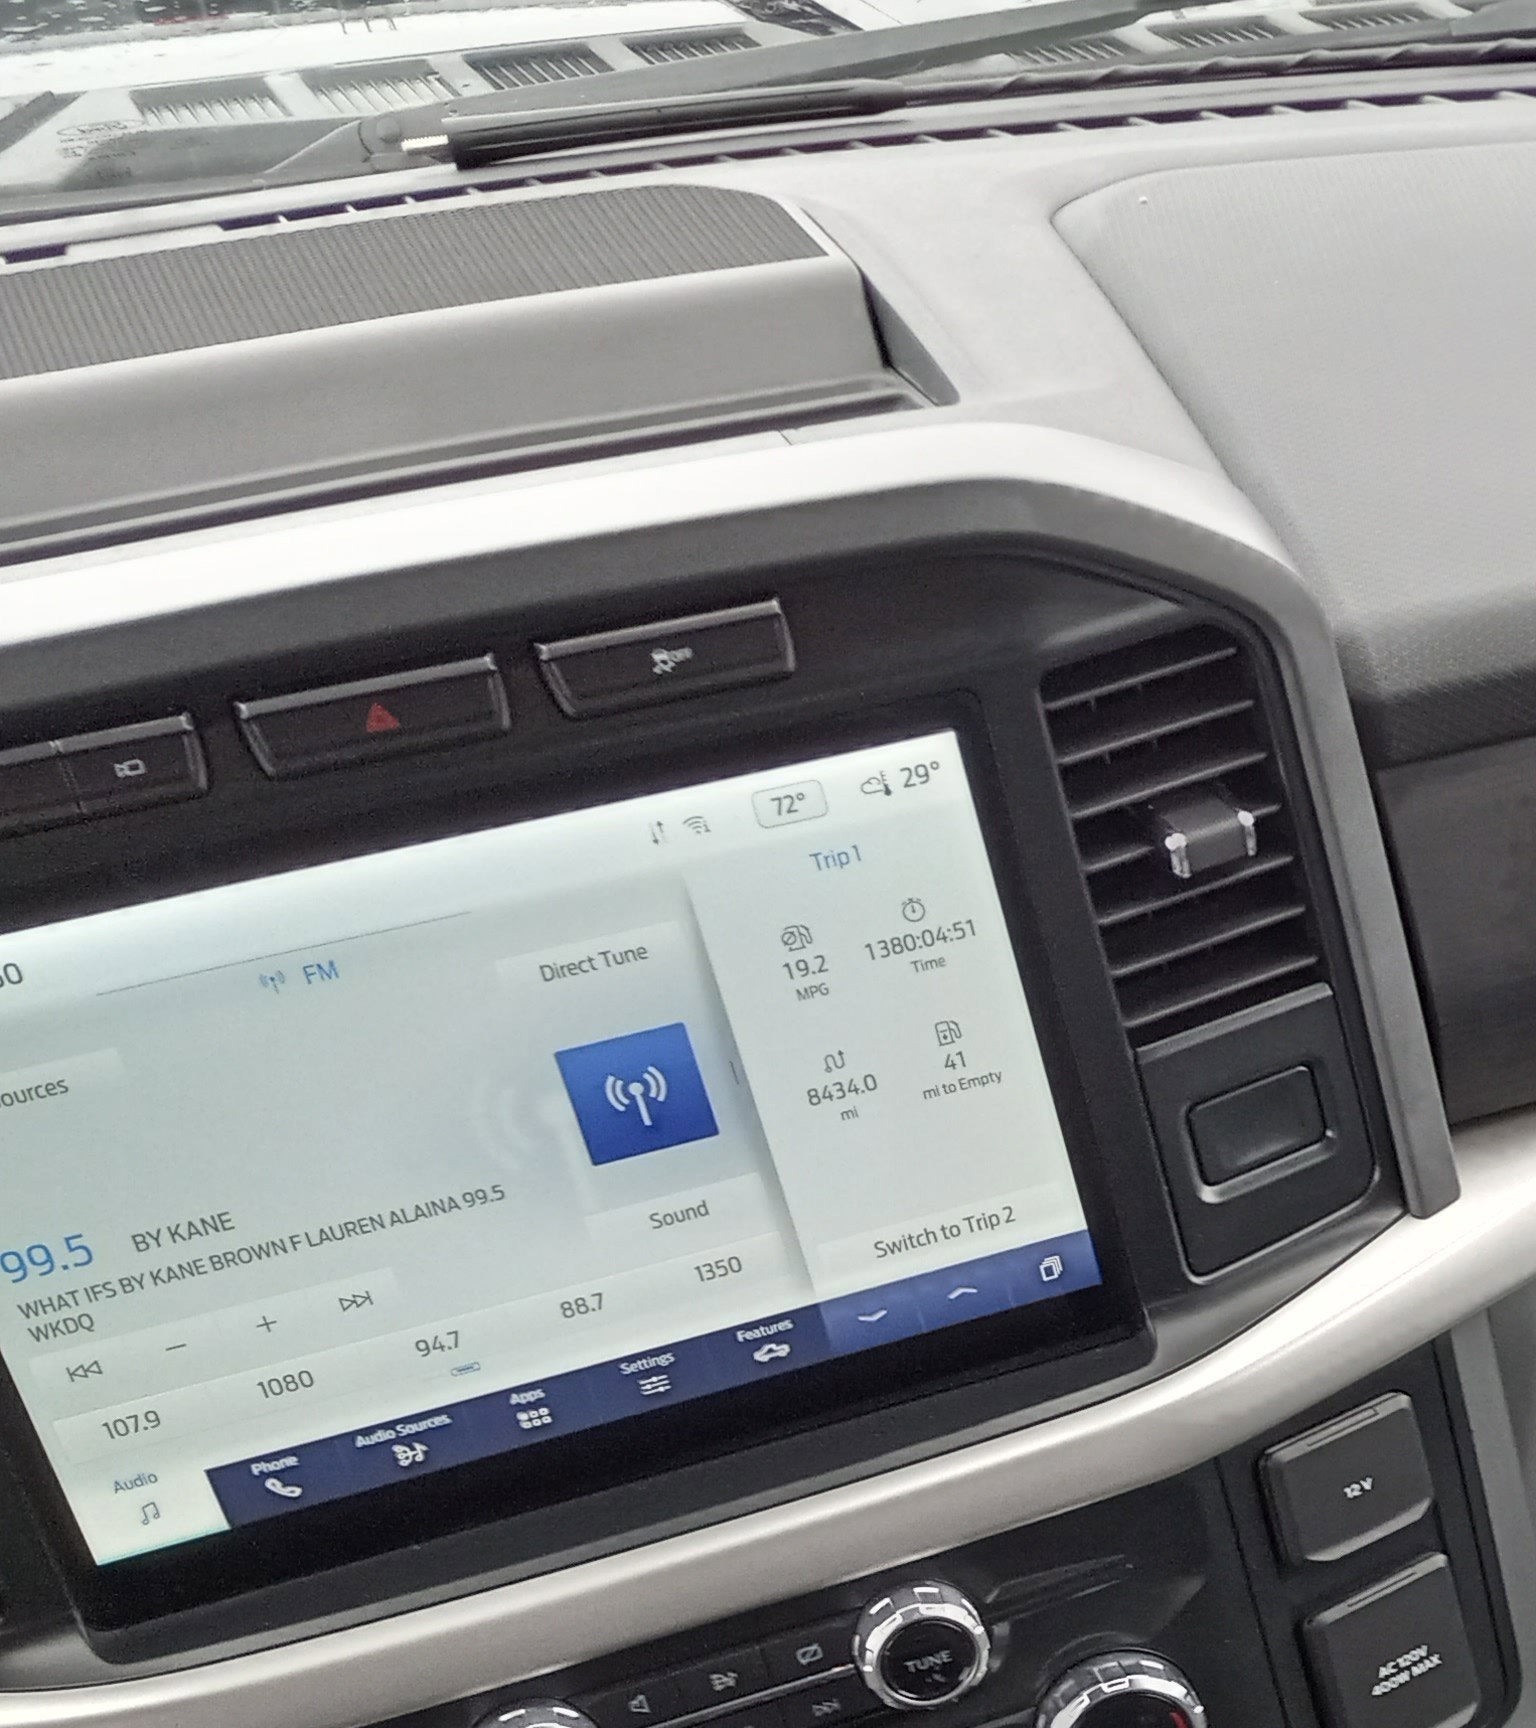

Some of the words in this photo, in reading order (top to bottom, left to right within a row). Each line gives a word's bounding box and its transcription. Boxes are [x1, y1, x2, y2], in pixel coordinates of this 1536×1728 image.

[809, 849, 850, 873] Trip
[864, 917, 978, 962] 1380:04:51
[0, 962, 24, 988] 0
[302, 959, 340, 985] FM
[539, 955, 599, 984] Direct
[598, 942, 649, 972] Tune
[782, 954, 830, 982] 19.2
[910, 953, 947, 976] Time
[795, 982, 830, 1003] MPG
[943, 1050, 967, 1073] 41
[0, 1077, 70, 1109] ources
[806, 1074, 878, 1107] 8434.0
[922, 1085, 940, 1101] mi
[941, 1080, 957, 1096] to
[957, 1068, 1003, 1094] Empty
[840, 1106, 859, 1122] mi
[649, 1200, 710, 1230] Sound
[131, 1228, 163, 1254] BY
[167, 1211, 236, 1244] KANE
[873, 1223, 940, 1260] Switch
[940, 1220, 962, 1241] to
[962, 1208, 1001, 1239] Trip
[999, 1205, 1017, 1227] 2
[0, 1233, 94, 1284] 99.5
[17, 1289, 80, 1320] WHAT
[83, 1281, 117, 1304] IFS
[118, 1273, 146, 1295] BY
[149, 1258, 209, 1287] KANE
[209, 1238, 289, 1273] BROWN
[288, 1234, 303, 1252] F
[304, 1213, 387, 1248] LAUREN
[389, 1196, 462, 1228] ALAINA
[461, 1184, 506, 1209] 99.5
[693, 1256, 743, 1283] 1350
[560, 1292, 605, 1319] 88.7
[27, 1313, 96, 1344] WKDQ
[736, 1319, 794, 1343] Features
[414, 1330, 461, 1358] 94.7
[619, 1352, 676, 1376] Settings
[256, 1369, 315, 1400] 1080
[509, 1388, 546, 1407] Apps
[101, 1409, 162, 1440] 107.9
[355, 1426, 397, 1450] Audio
[395, 1411, 453, 1438] Sources
[250, 1452, 300, 1477] Phone
[113, 1470, 158, 1495] Audio
[904, 1648, 953, 1672] TUNE
[1411, 1653, 1443, 1677] MAX
